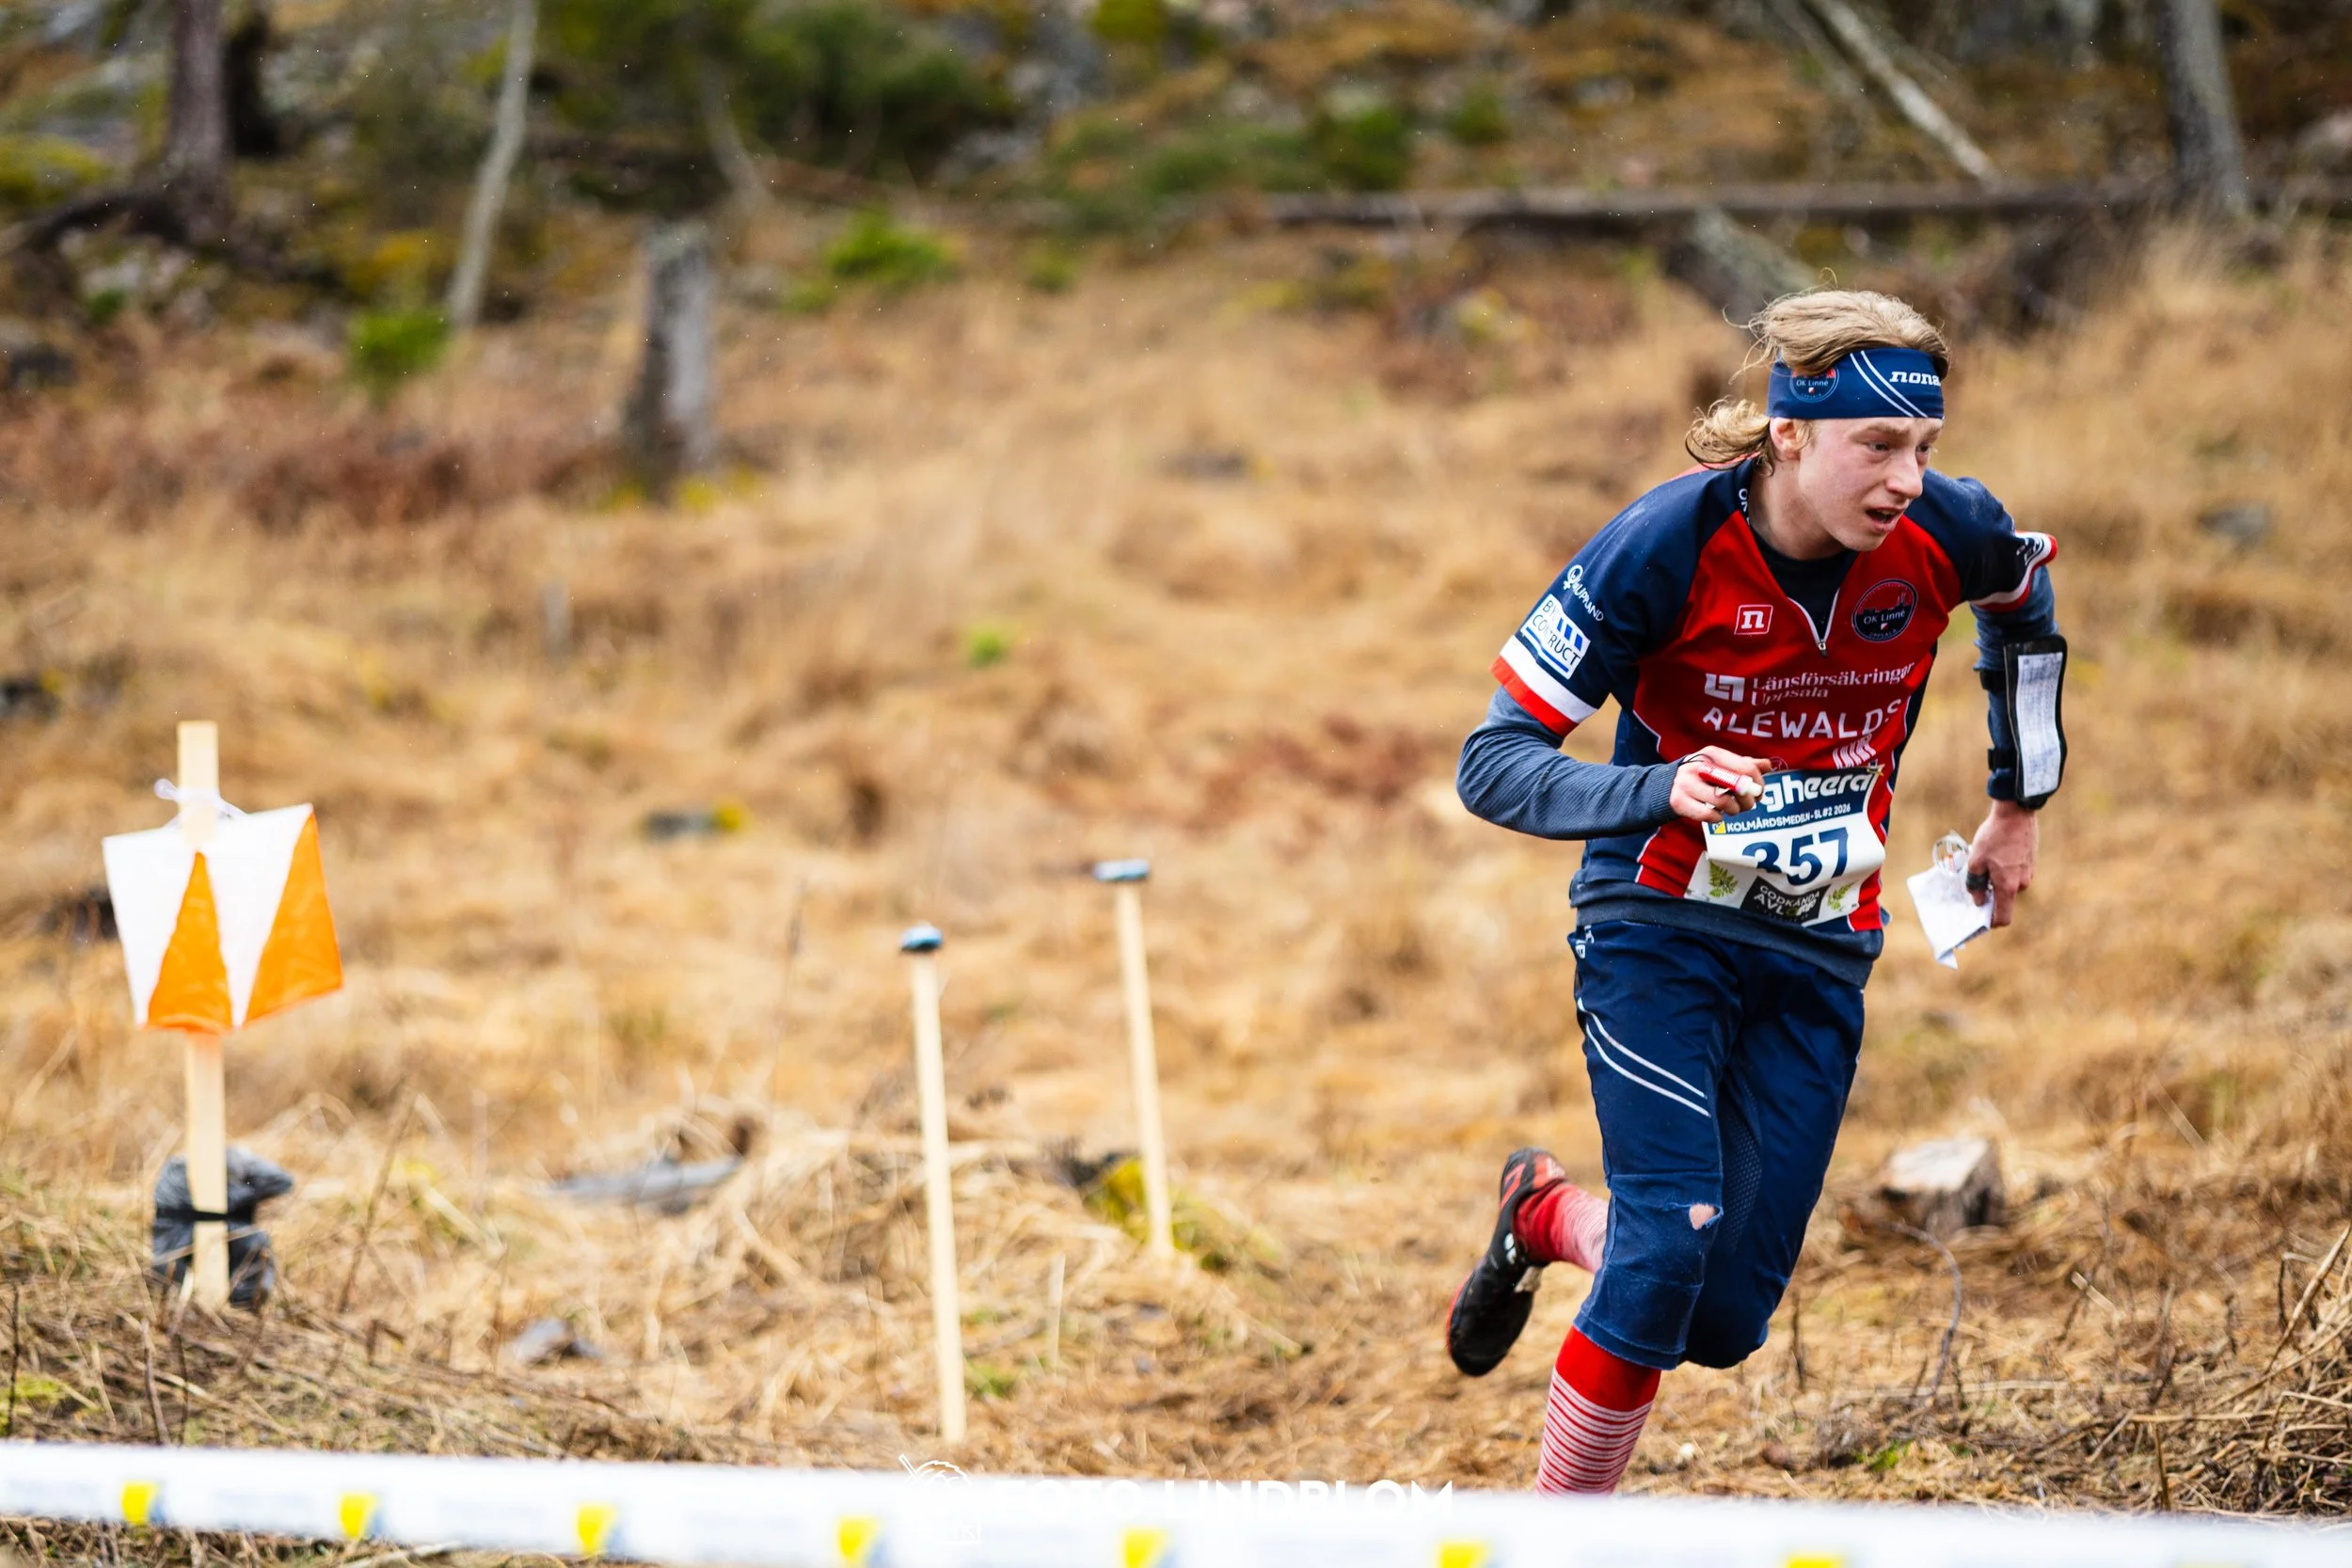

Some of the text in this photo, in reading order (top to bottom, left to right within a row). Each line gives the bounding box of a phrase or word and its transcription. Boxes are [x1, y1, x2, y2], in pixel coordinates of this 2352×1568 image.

[1864, 610, 1906, 625] OK Linné
[1753, 773, 1872, 813] gheera
[1834, 803, 1851, 816] 2026
[1741, 827, 1849, 886] 357
